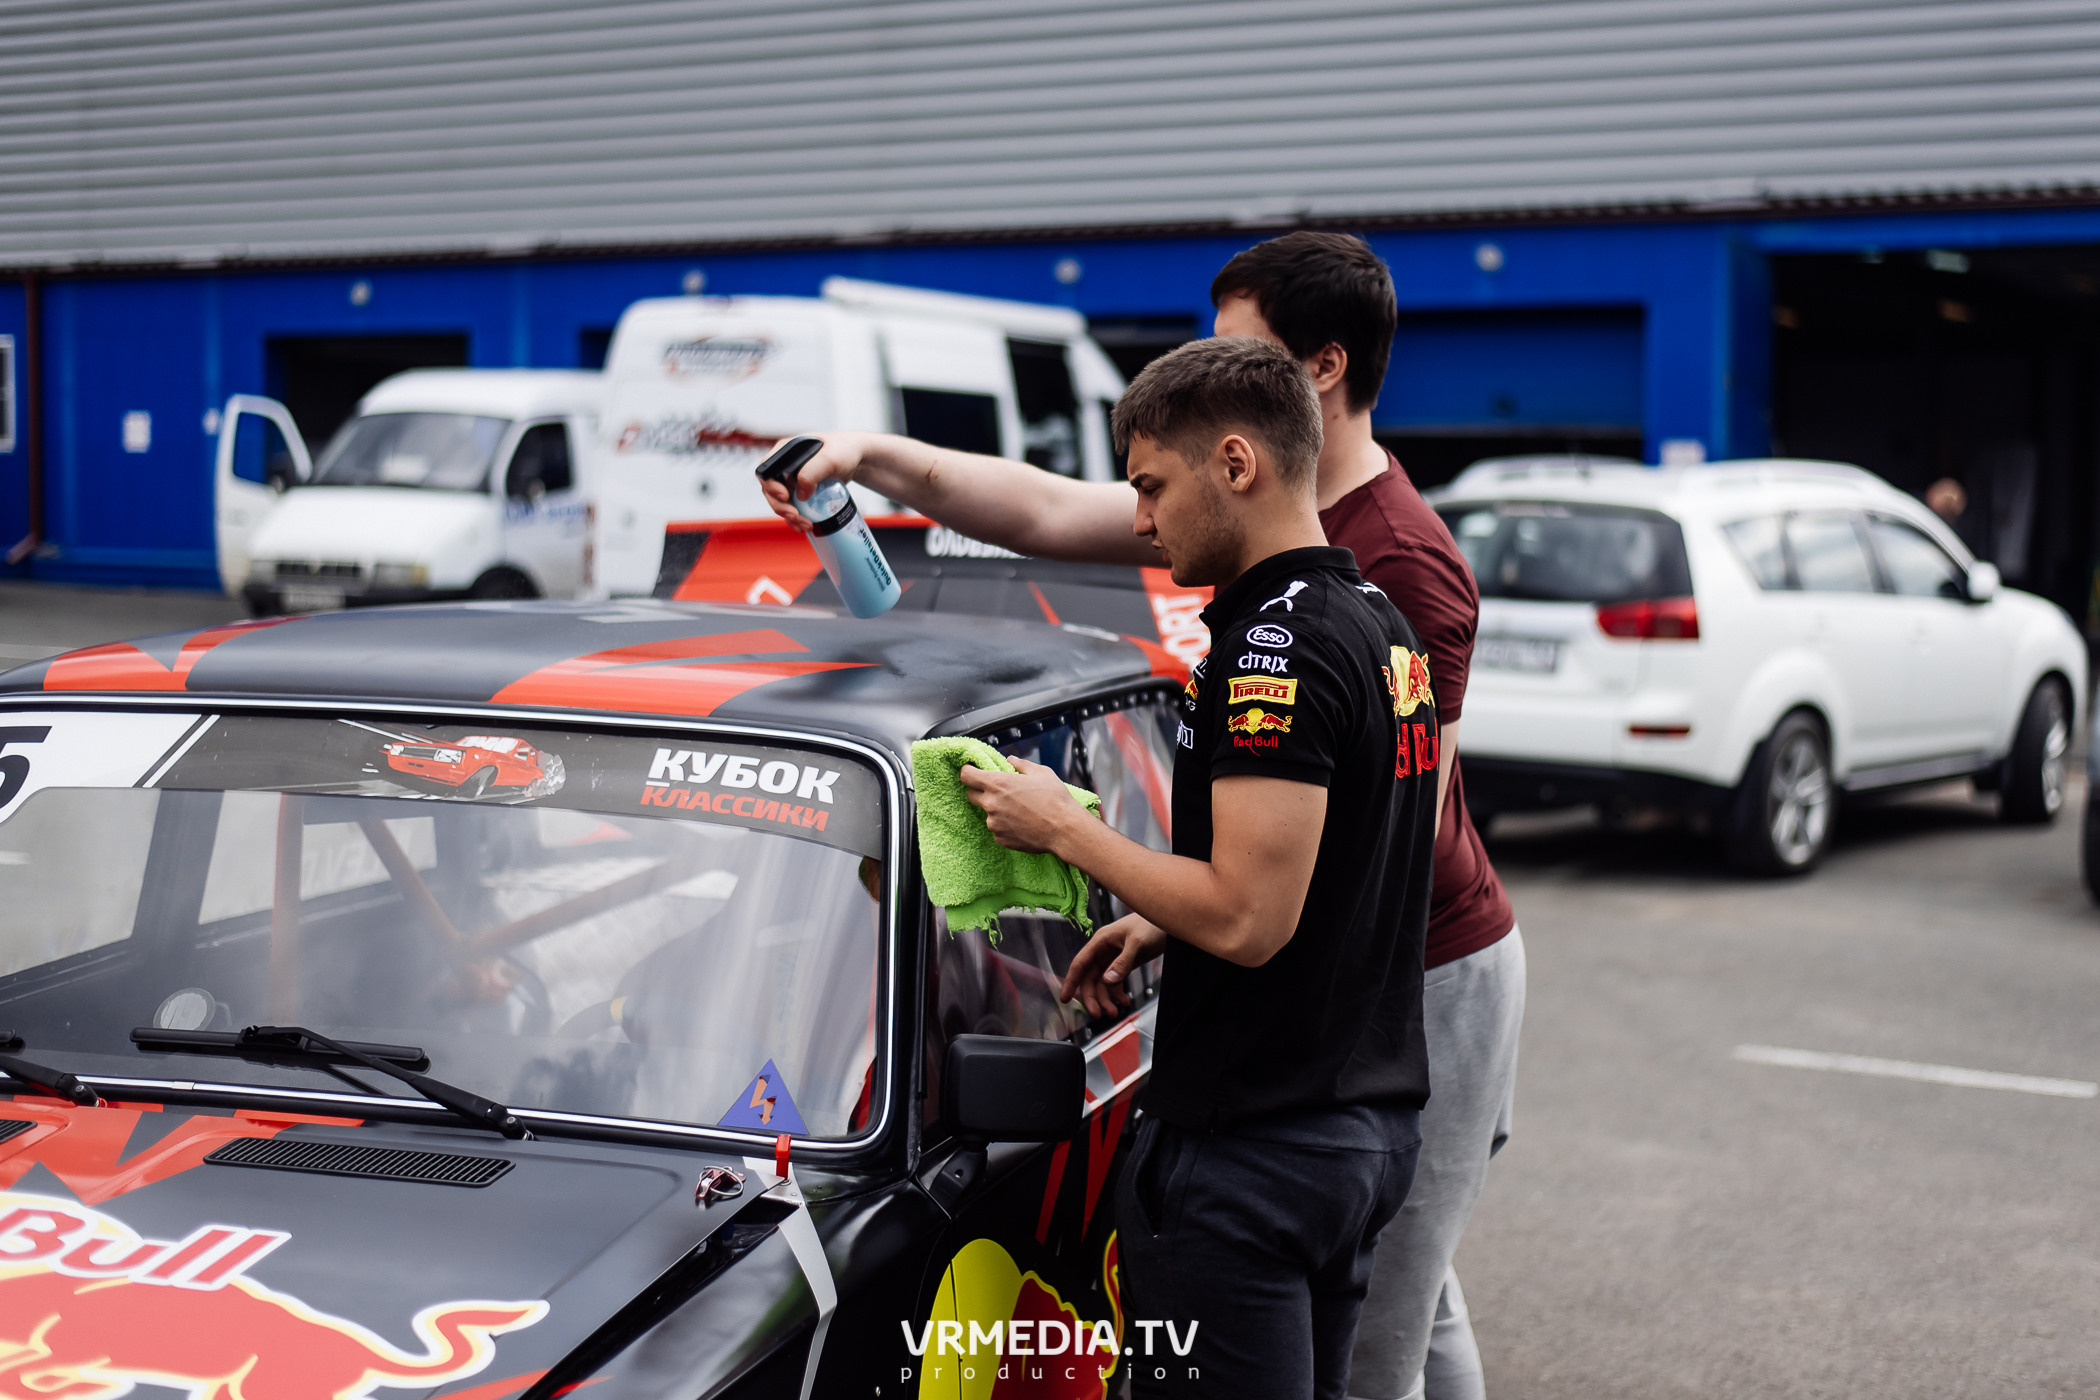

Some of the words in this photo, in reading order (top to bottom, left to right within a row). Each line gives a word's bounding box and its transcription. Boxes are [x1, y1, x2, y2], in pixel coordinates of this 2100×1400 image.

[860, 528, 892, 586] QuickDetailer
[1253, 628, 1285, 644] Esso
[1233, 681, 1289, 699] PIRELLI
[1233, 735, 1253, 748] Red
[1254, 735, 1279, 748] Bull
[647, 747, 841, 805] КУБОК
[640, 785, 830, 832] КЛАССИКИ
[0, 1206, 287, 1288] Bull
